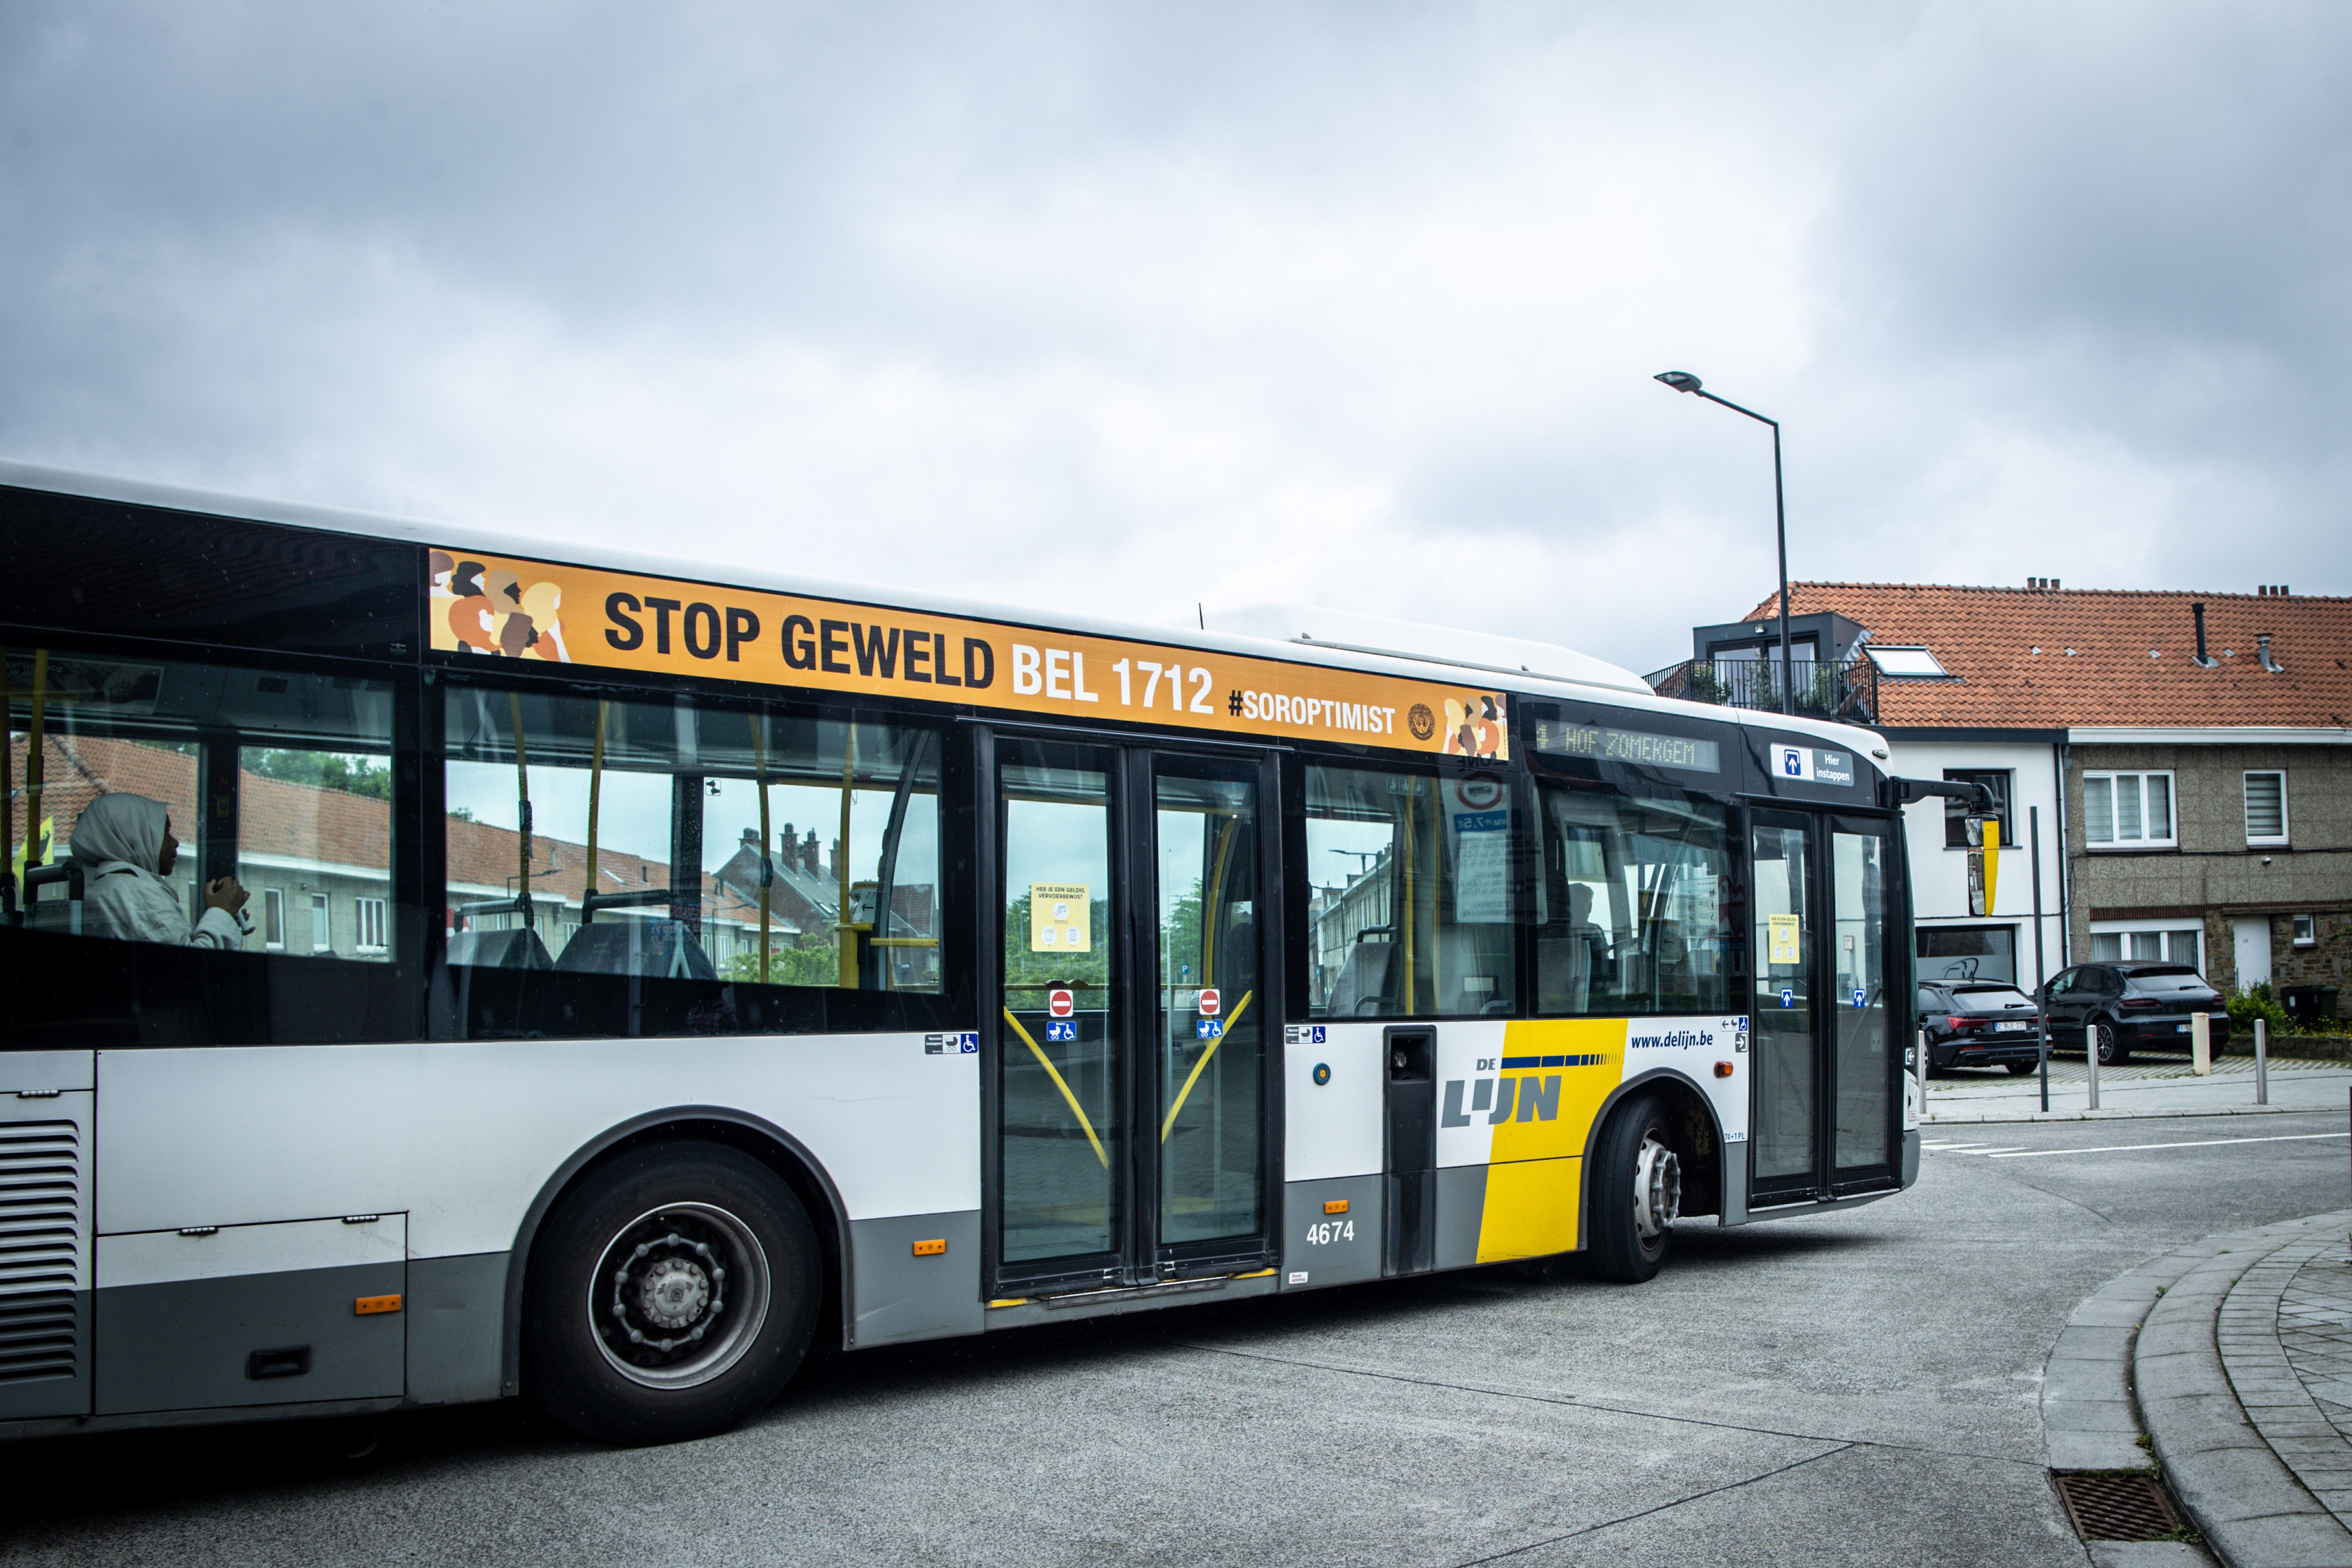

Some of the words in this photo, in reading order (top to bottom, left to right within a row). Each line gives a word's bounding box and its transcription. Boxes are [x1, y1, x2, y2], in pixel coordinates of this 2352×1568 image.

[605, 592, 760, 662] STOP
[781, 614, 995, 689] GEWELD
[1012, 643, 1099, 702] BEL
[1112, 658, 1214, 715] 1712
[1228, 689, 1396, 742] #SOROPTIMIST
[1536, 724, 1549, 749] 4
[1566, 727, 1599, 754] HOF
[1825, 754, 1840, 766] Hier
[1816, 767, 1850, 782] instappen
[1631, 1030, 1713, 1050] www.delijn.be
[1476, 1058, 1496, 1071] DE
[1441, 1075, 1562, 1128] LIJN
[1306, 1220, 1354, 1245] 4674
